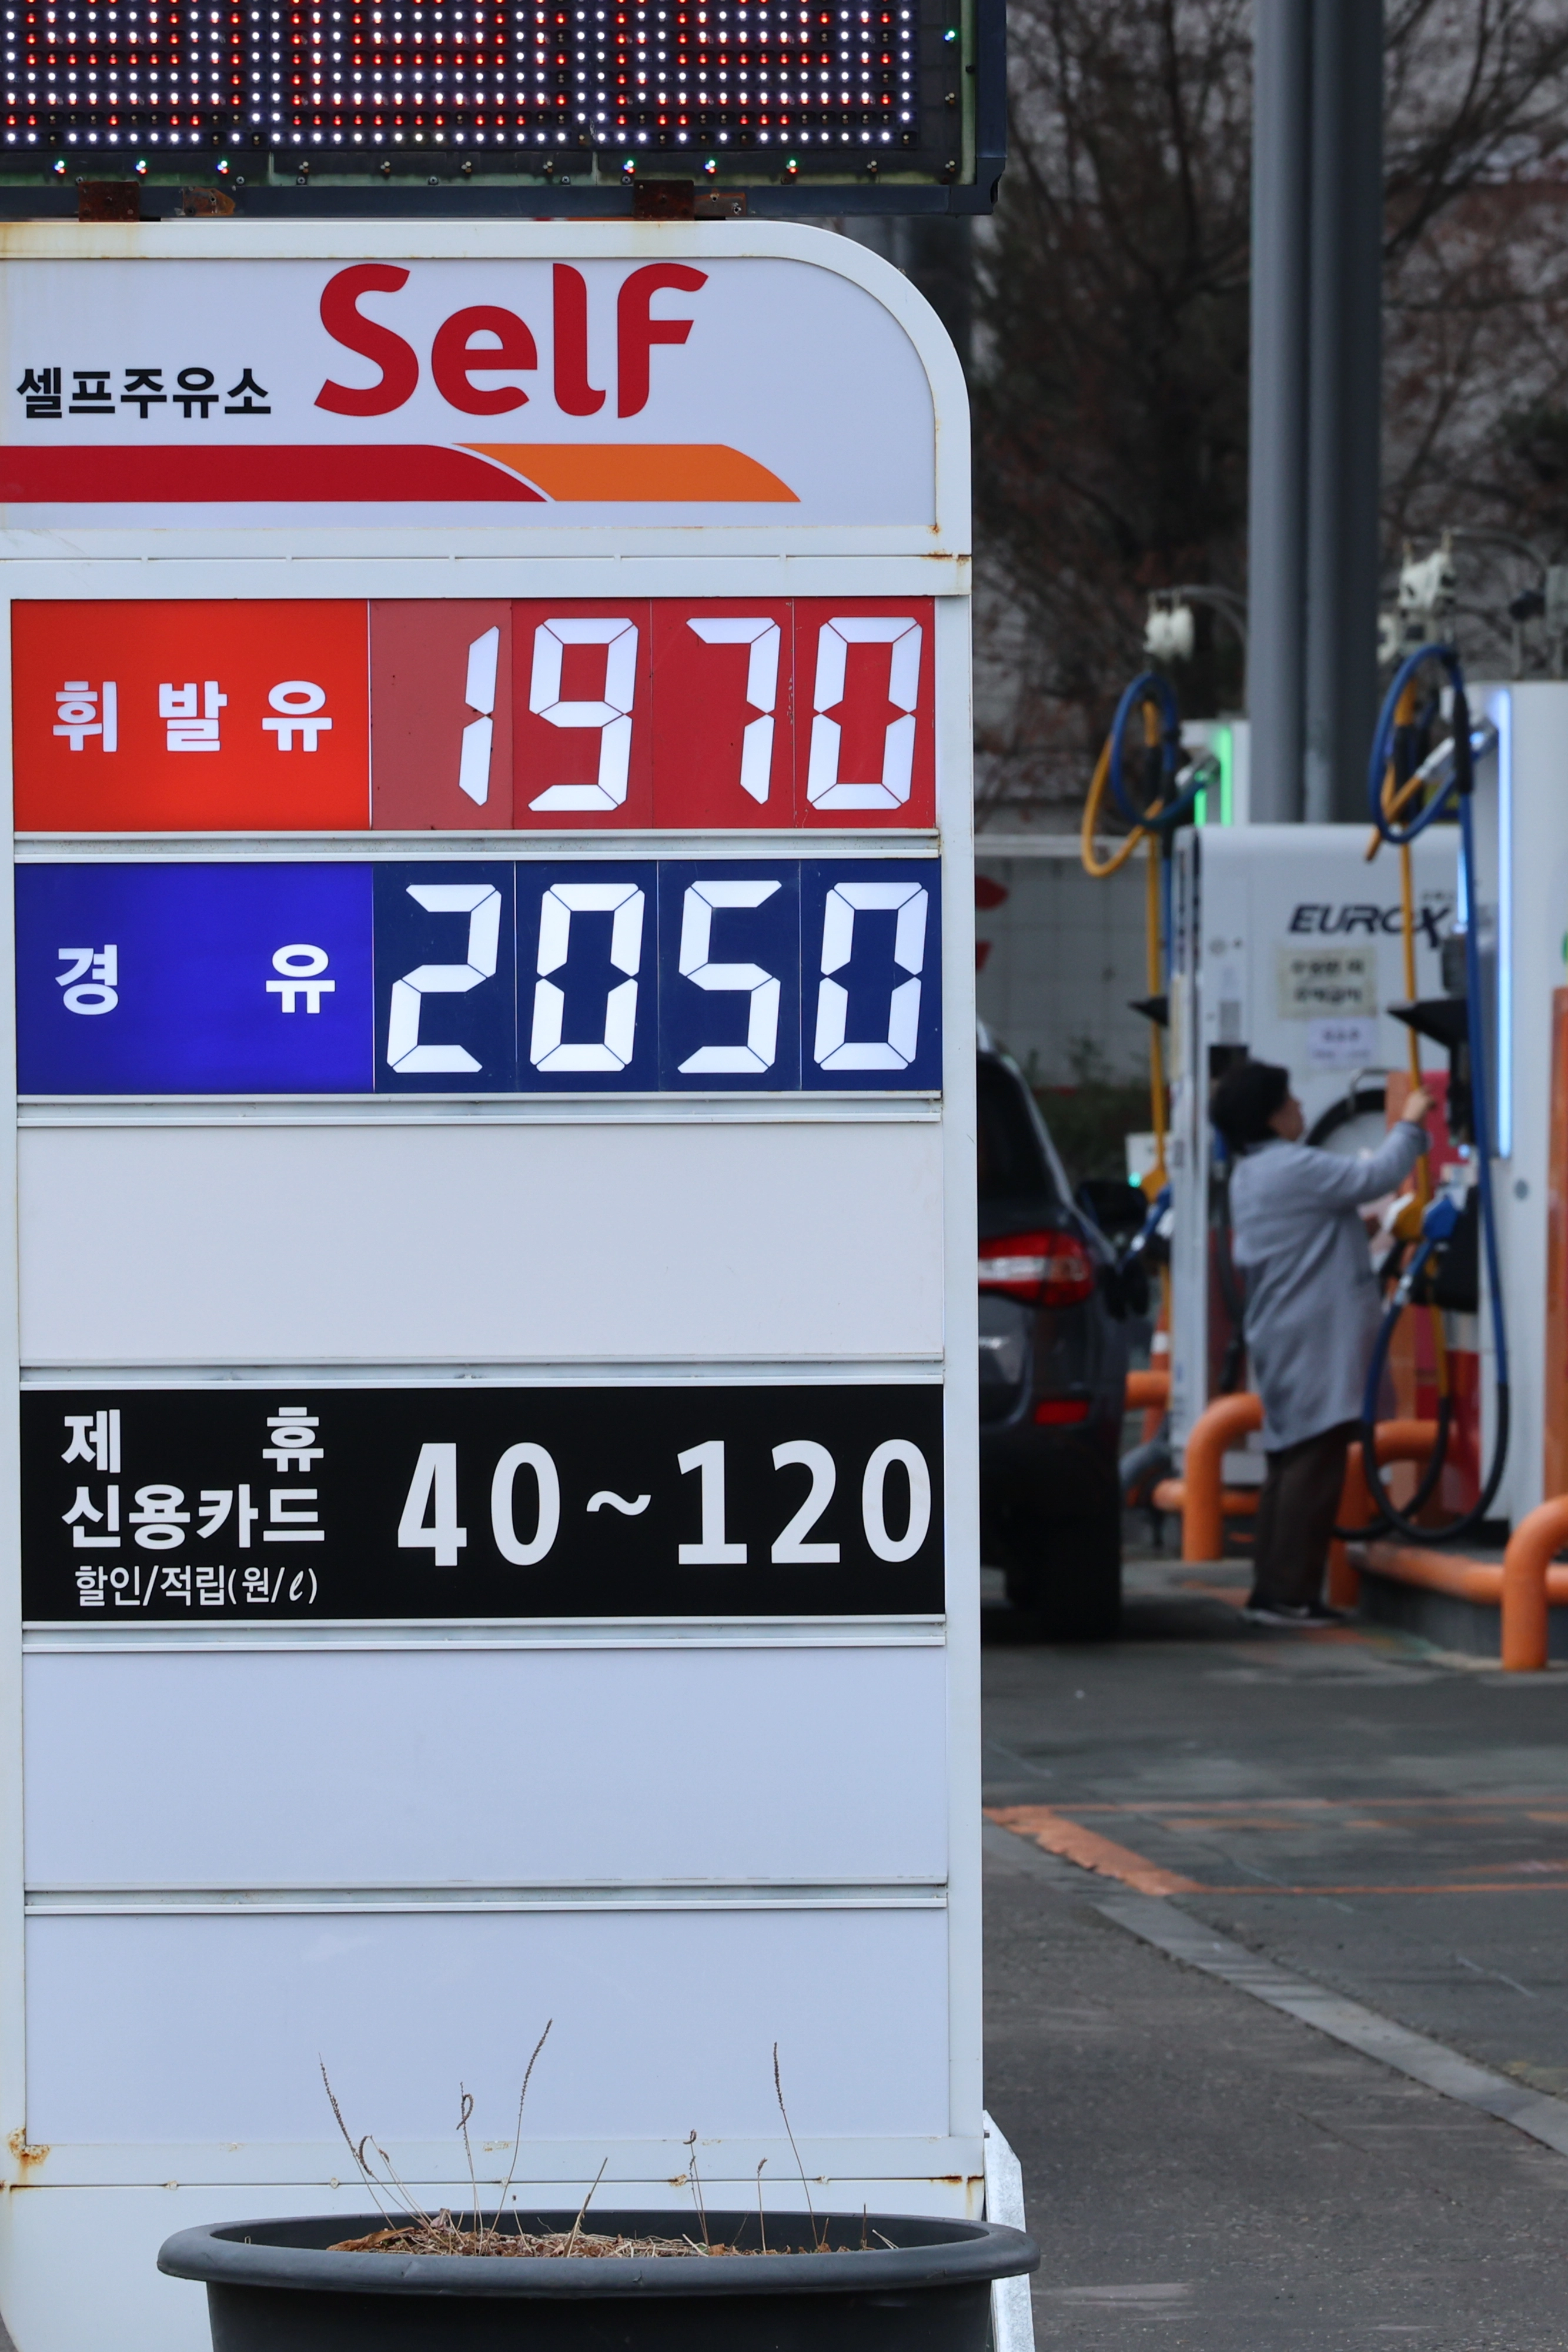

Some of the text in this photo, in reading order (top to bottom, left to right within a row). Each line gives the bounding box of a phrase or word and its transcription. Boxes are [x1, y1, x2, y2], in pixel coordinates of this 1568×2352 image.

[16, 367, 271, 419] 셀프주유소
[316, 263, 708, 418] Self
[459, 617, 923, 811] 1970
[386, 880, 929, 1073] 2050
[61, 1484, 325, 1550] 신용카드
